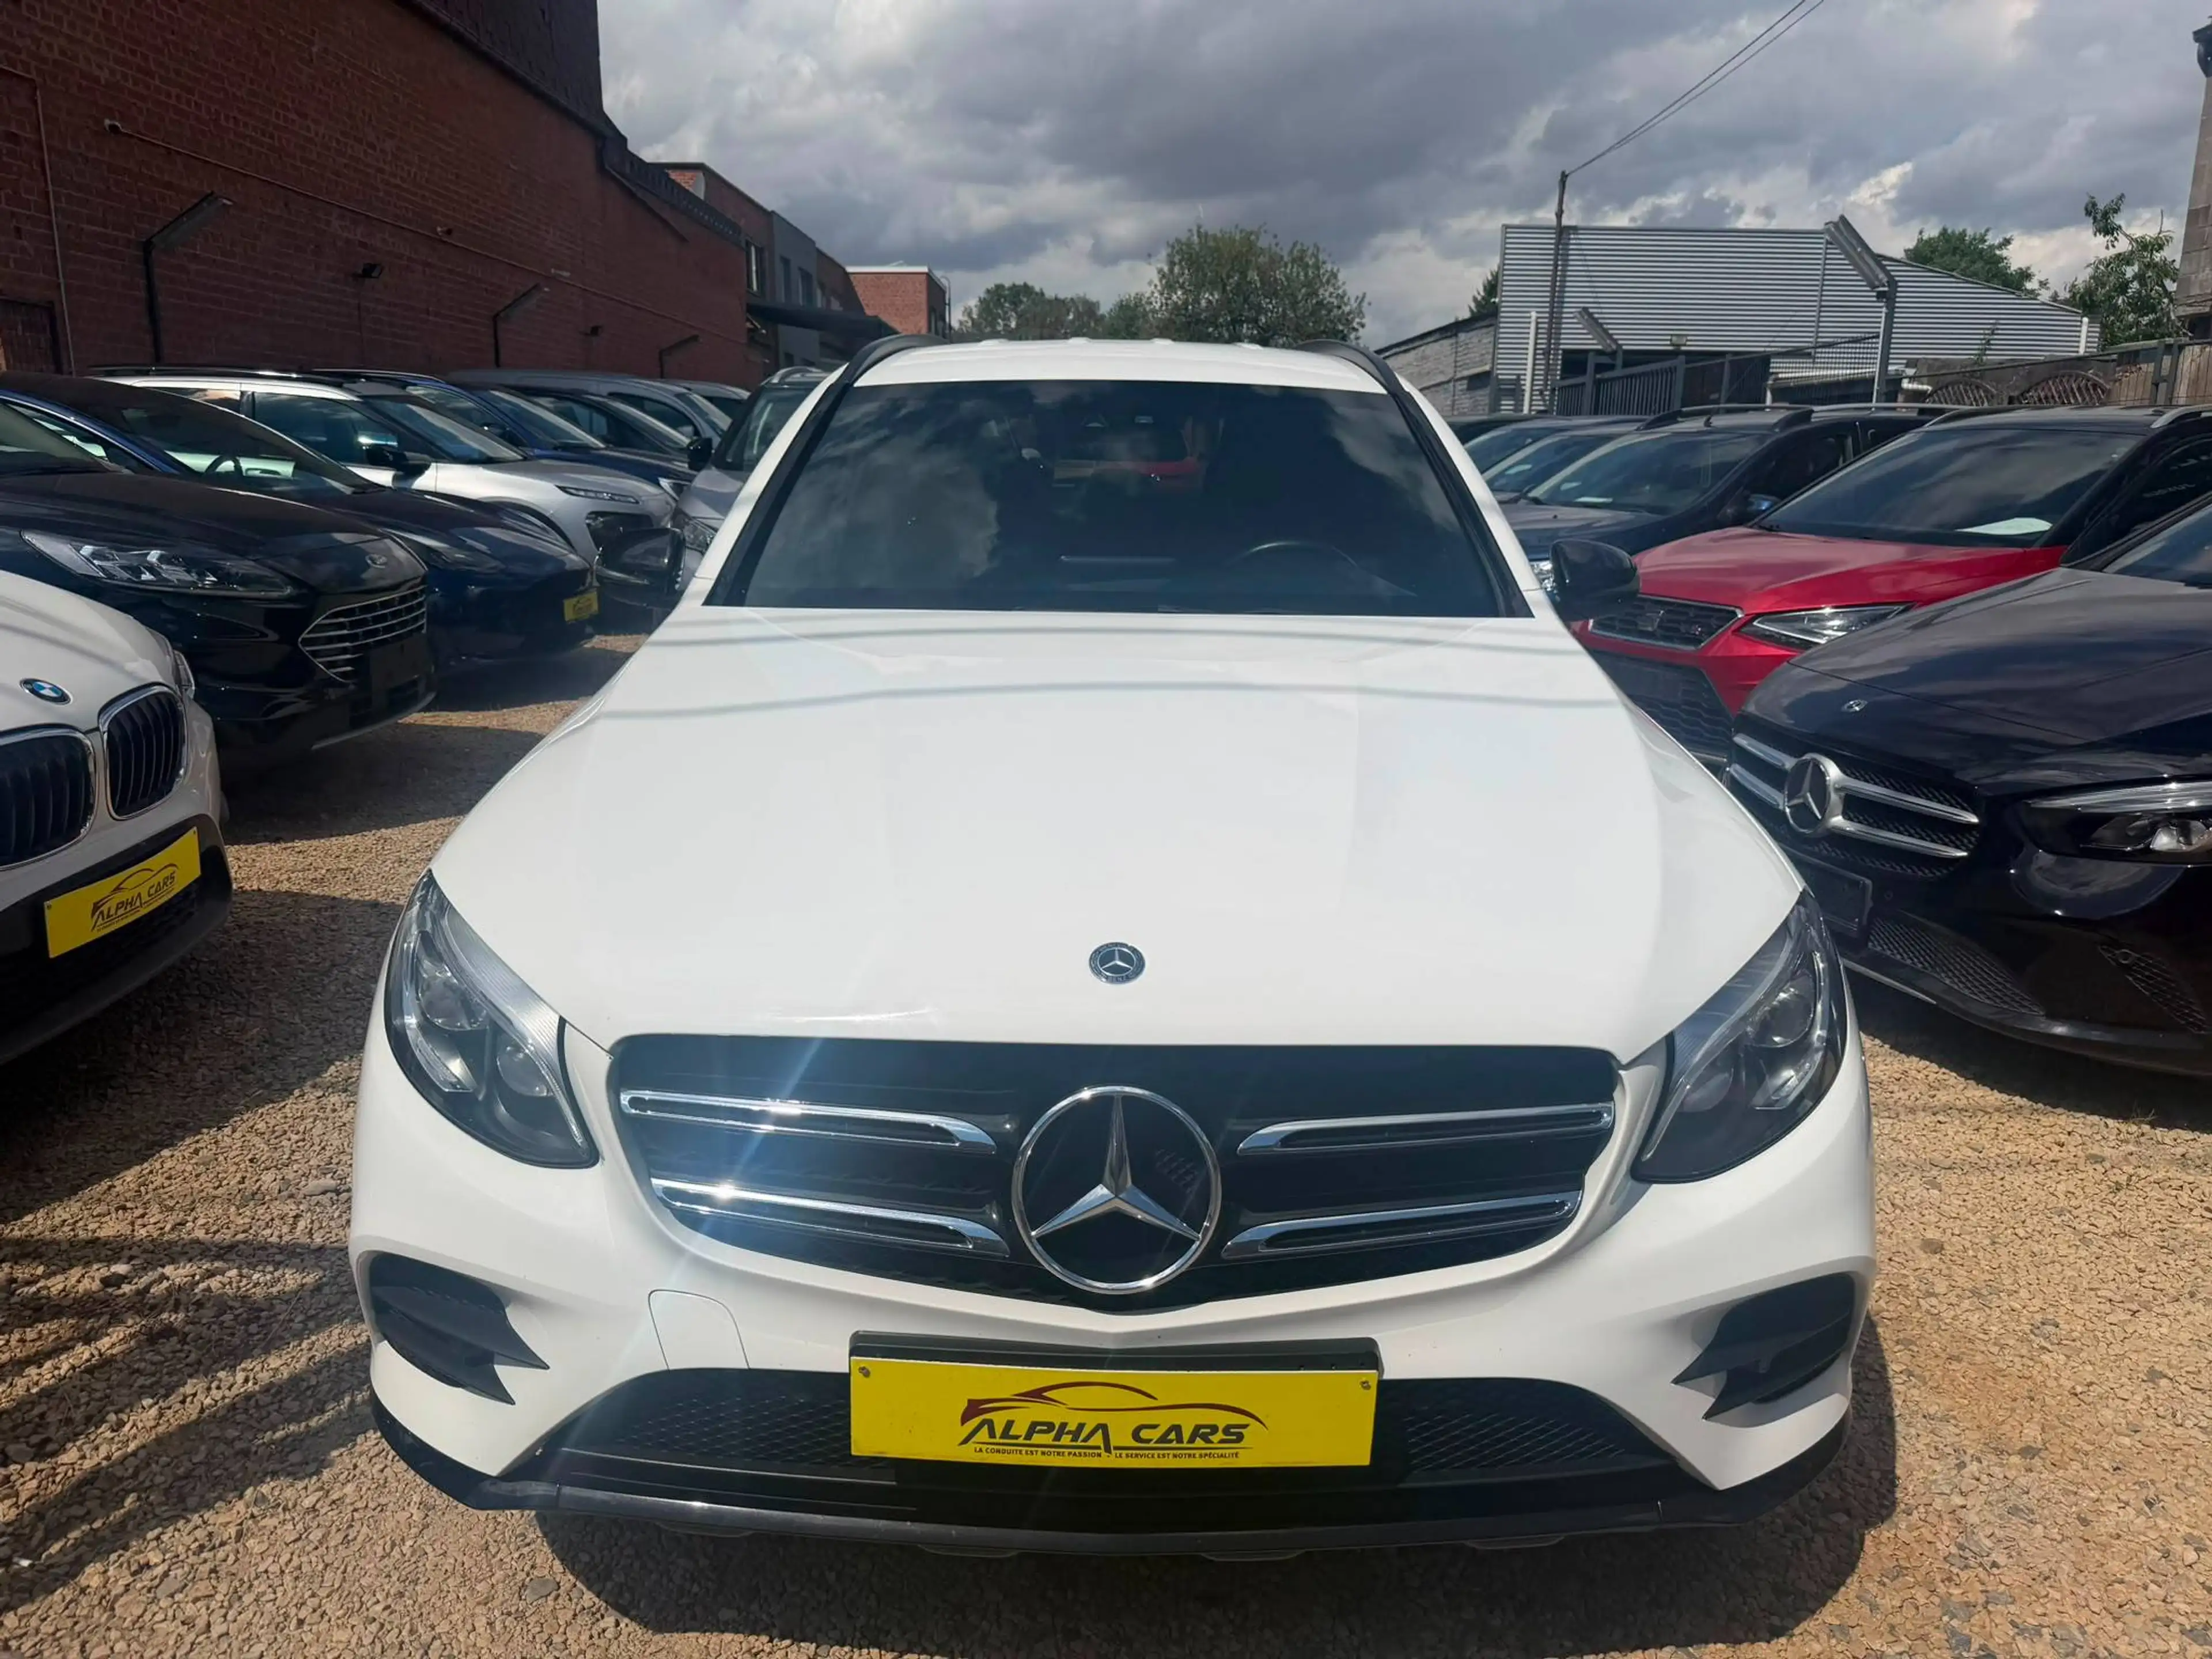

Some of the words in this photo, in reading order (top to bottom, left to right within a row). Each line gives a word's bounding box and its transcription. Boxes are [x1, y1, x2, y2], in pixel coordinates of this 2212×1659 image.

[91, 892, 143, 932] ALPHA
[147, 870, 176, 897] CARS
[957, 1418, 1112, 1455] ALPHA
[1131, 1423, 1251, 1445] CARS
[986, 1447, 1023, 1455] CONDUITE
[1199, 1450, 1240, 1459] SPÉCIALITÉ
